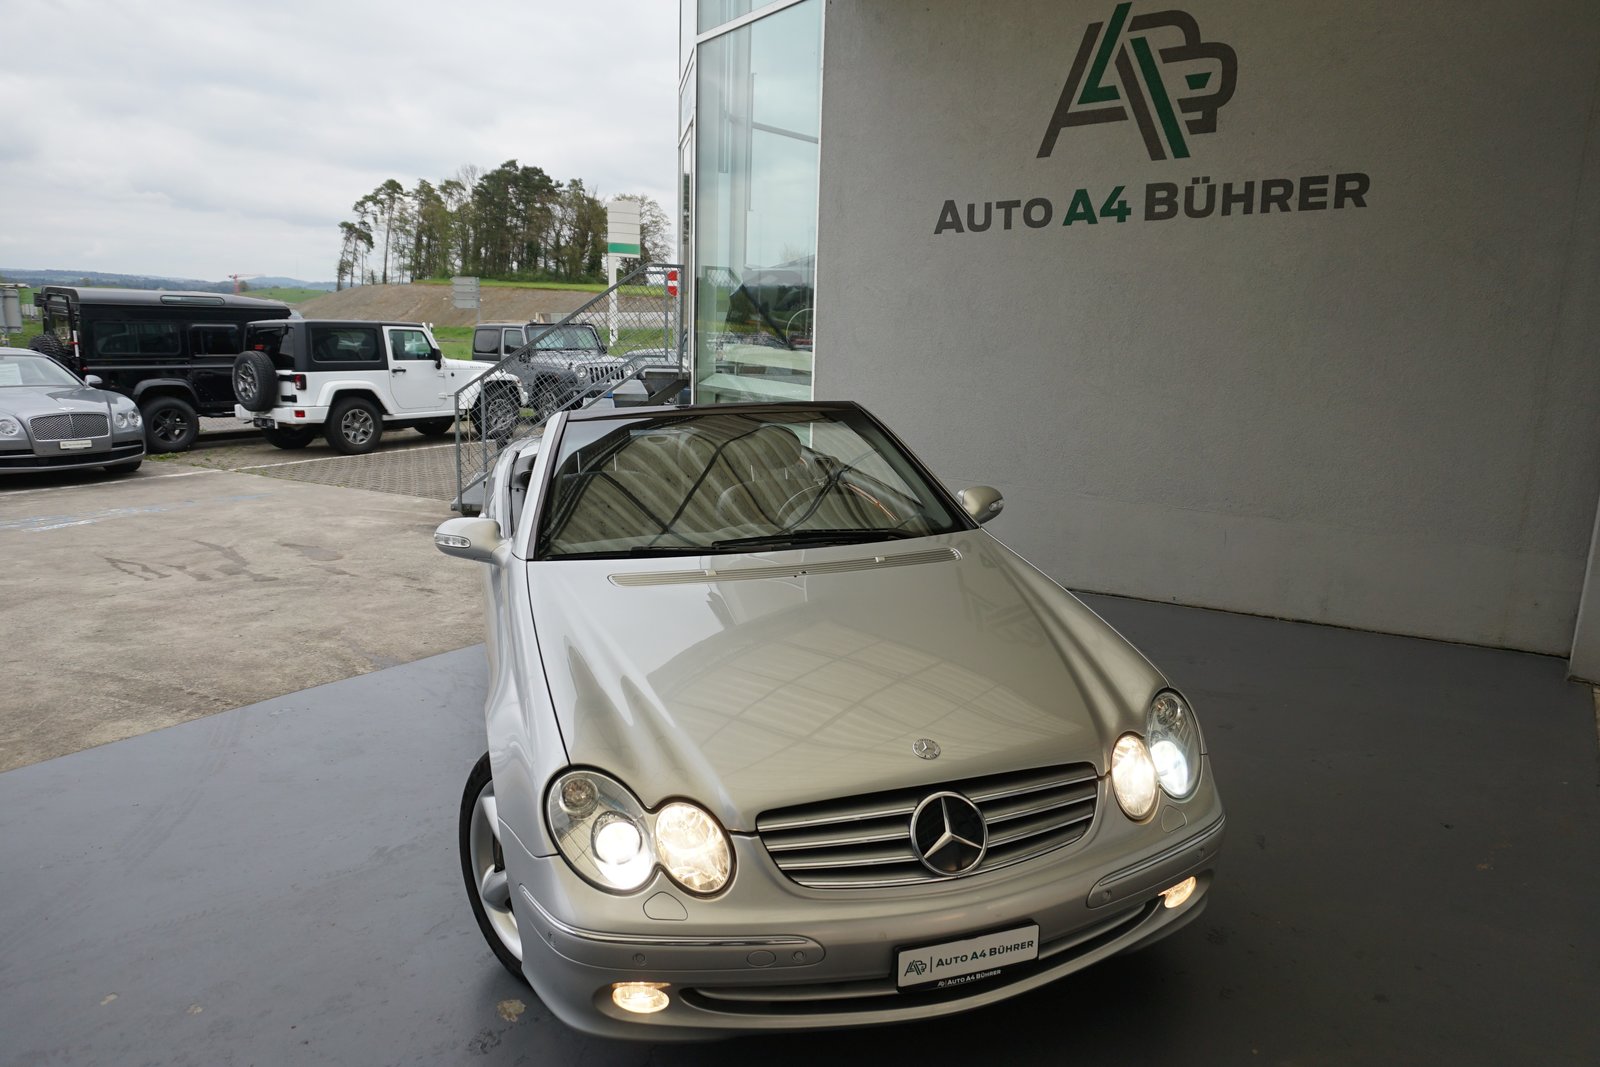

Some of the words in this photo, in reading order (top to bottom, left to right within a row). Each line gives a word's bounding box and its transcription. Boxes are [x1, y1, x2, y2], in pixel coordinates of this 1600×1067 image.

[934, 197, 1053, 234] AUTO
[1062, 185, 1131, 227] A4
[1144, 172, 1371, 221] BÜHRER
[936, 954, 968, 968] AUTO
[970, 949, 987, 960] A4
[989, 940, 1034, 957] BÜHRER
[947, 977, 965, 986] AUTO
